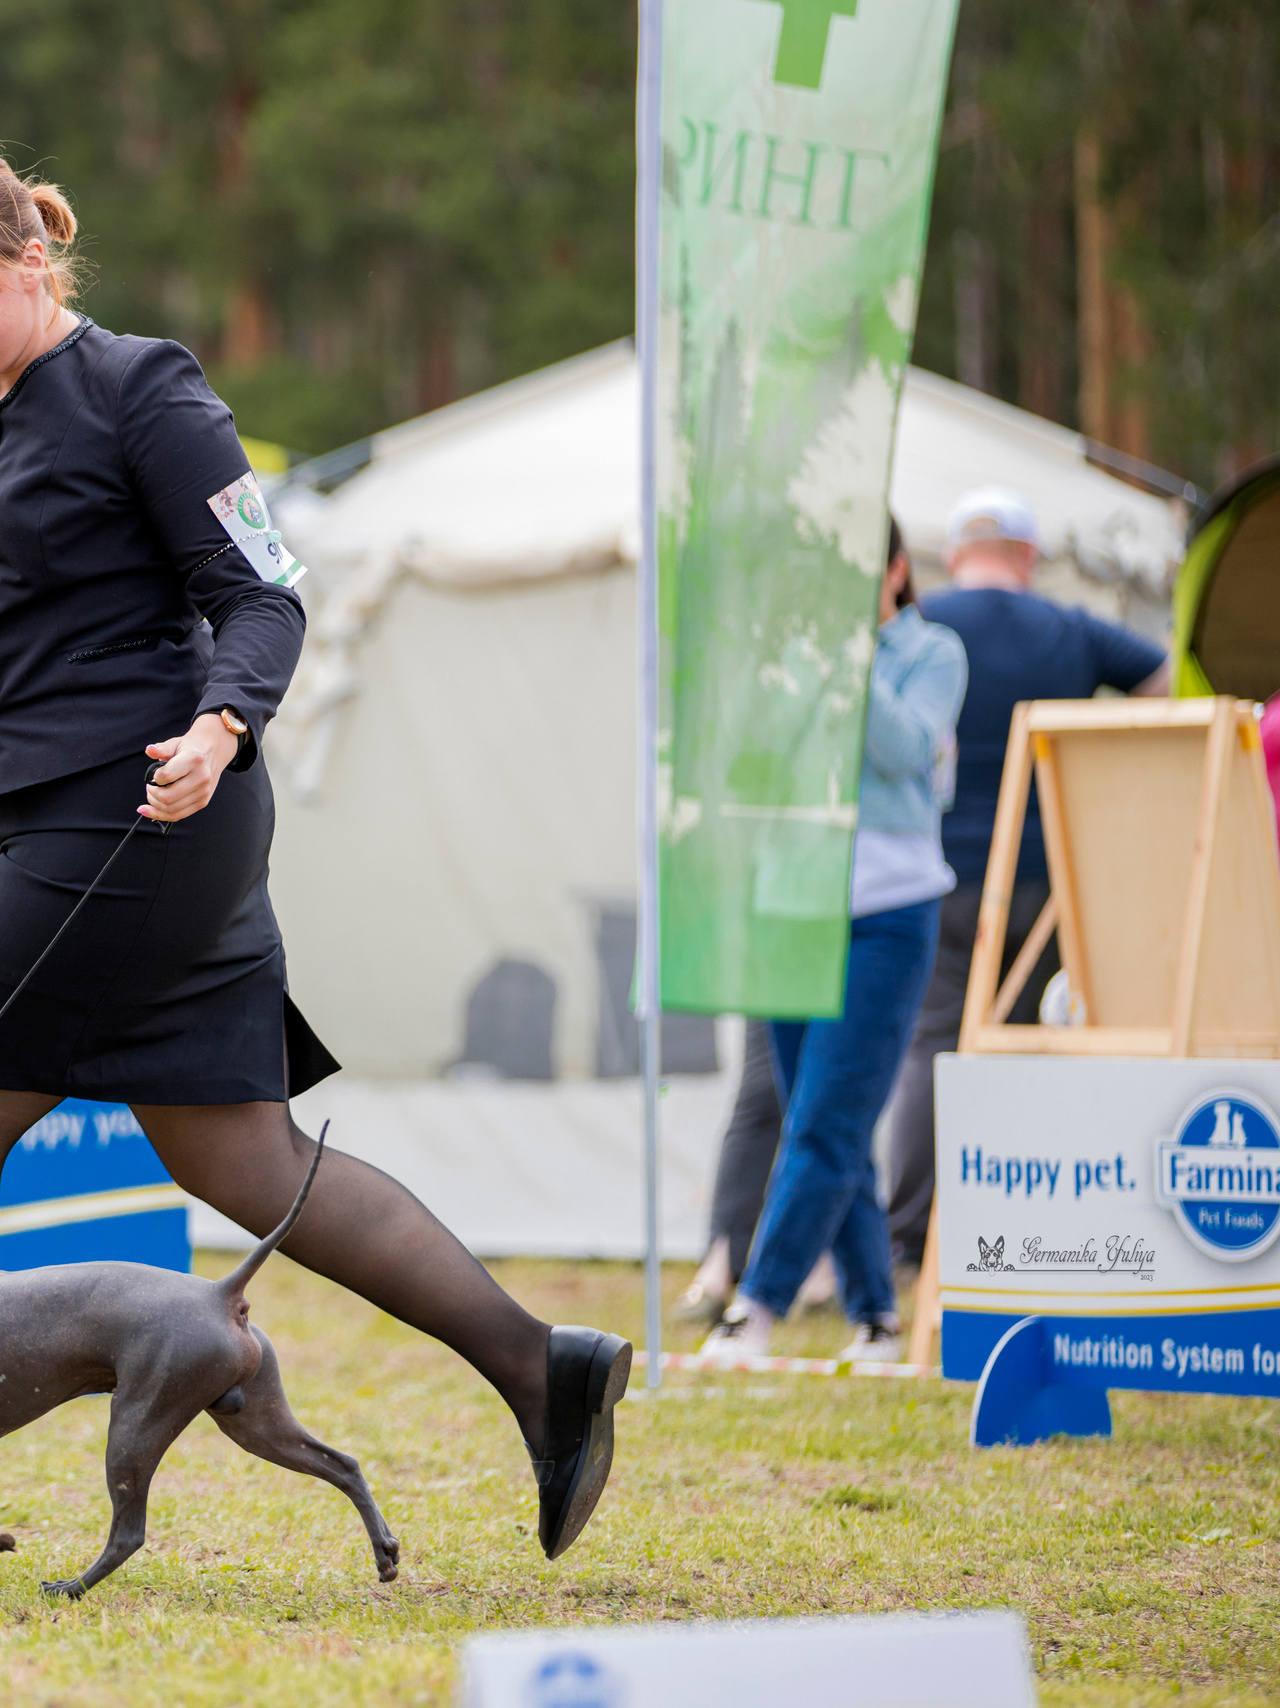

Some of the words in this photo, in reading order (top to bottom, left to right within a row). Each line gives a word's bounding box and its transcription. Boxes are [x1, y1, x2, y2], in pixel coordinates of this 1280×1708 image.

[22, 1111, 86, 1154] ppy
[961, 1146, 1061, 1198] Happy
[1075, 1152, 1137, 1200] pet.
[1199, 1207, 1221, 1230] Pet
[1225, 1208, 1265, 1232] Foods
[1054, 1332, 1154, 1369] Nutrition
[1161, 1337, 1245, 1378] System
